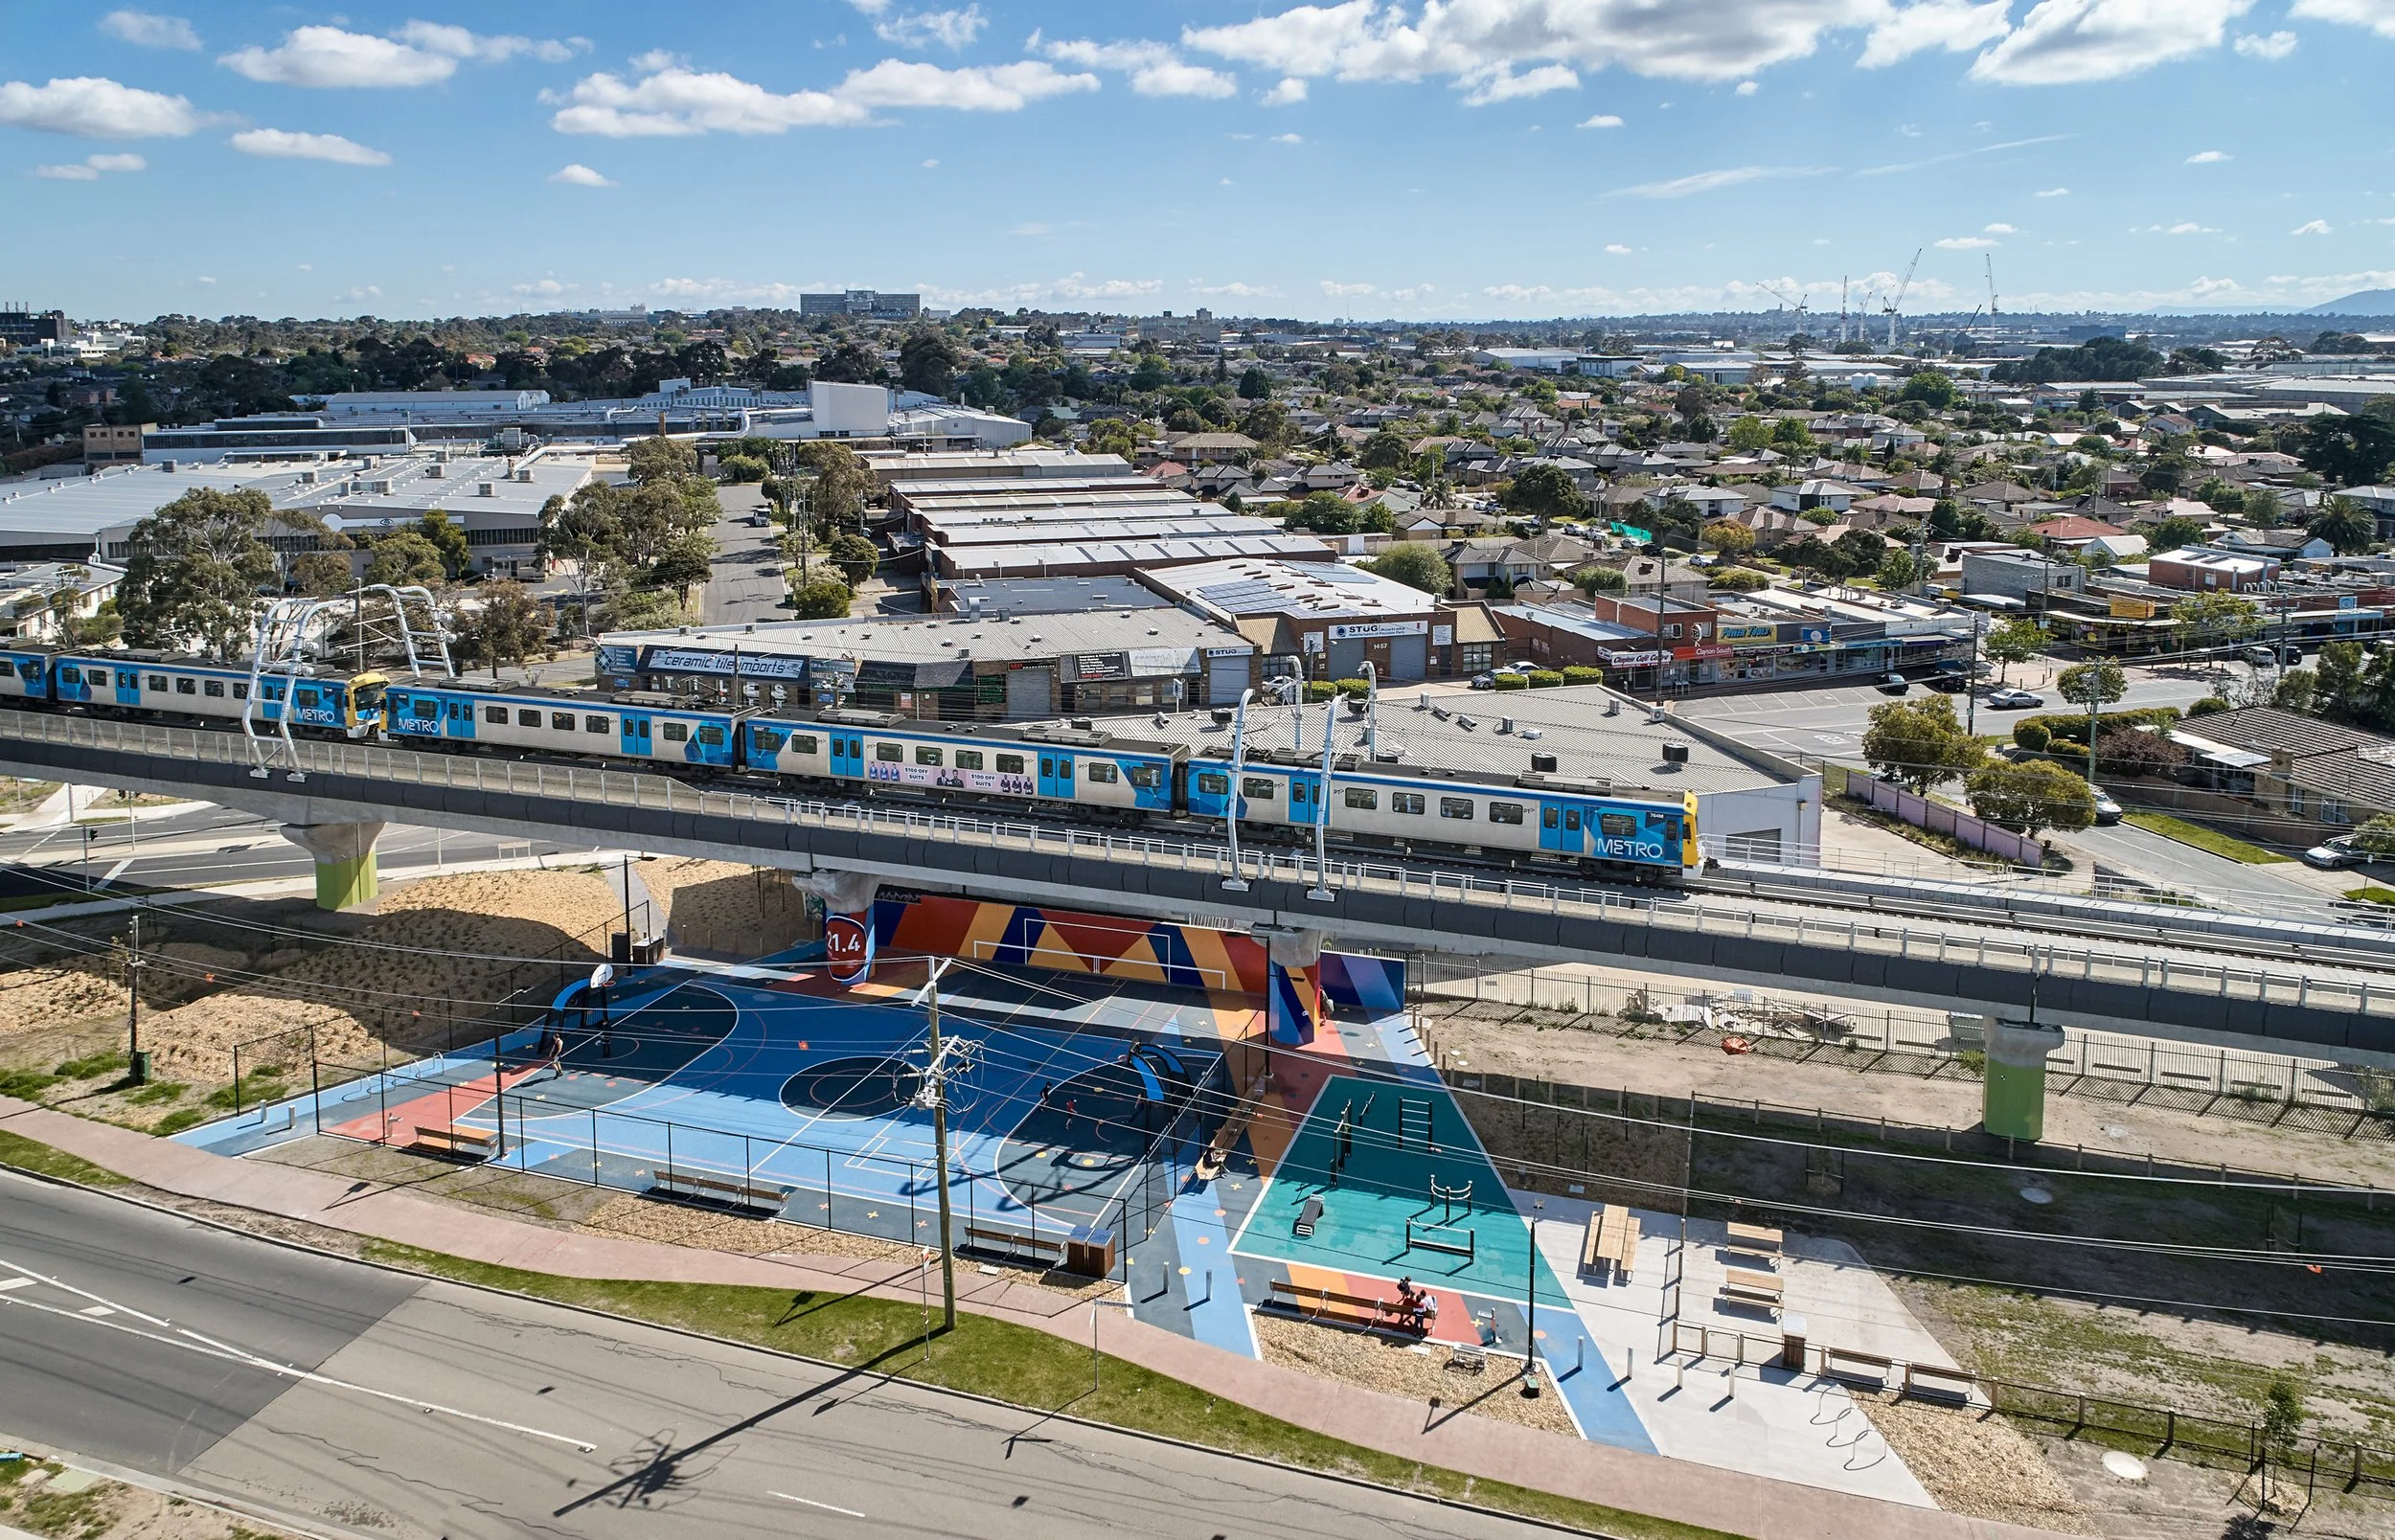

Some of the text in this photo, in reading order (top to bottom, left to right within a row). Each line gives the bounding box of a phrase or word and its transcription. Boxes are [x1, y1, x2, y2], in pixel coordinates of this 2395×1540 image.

[1697, 647, 1716, 656] Clayton
[665, 655, 786, 673] ceramic tile imports
[296, 708, 334, 722] METRO
[399, 719, 439, 733] METRO
[1597, 837, 1663, 859] METRO
[828, 930, 860, 952] 21.4
